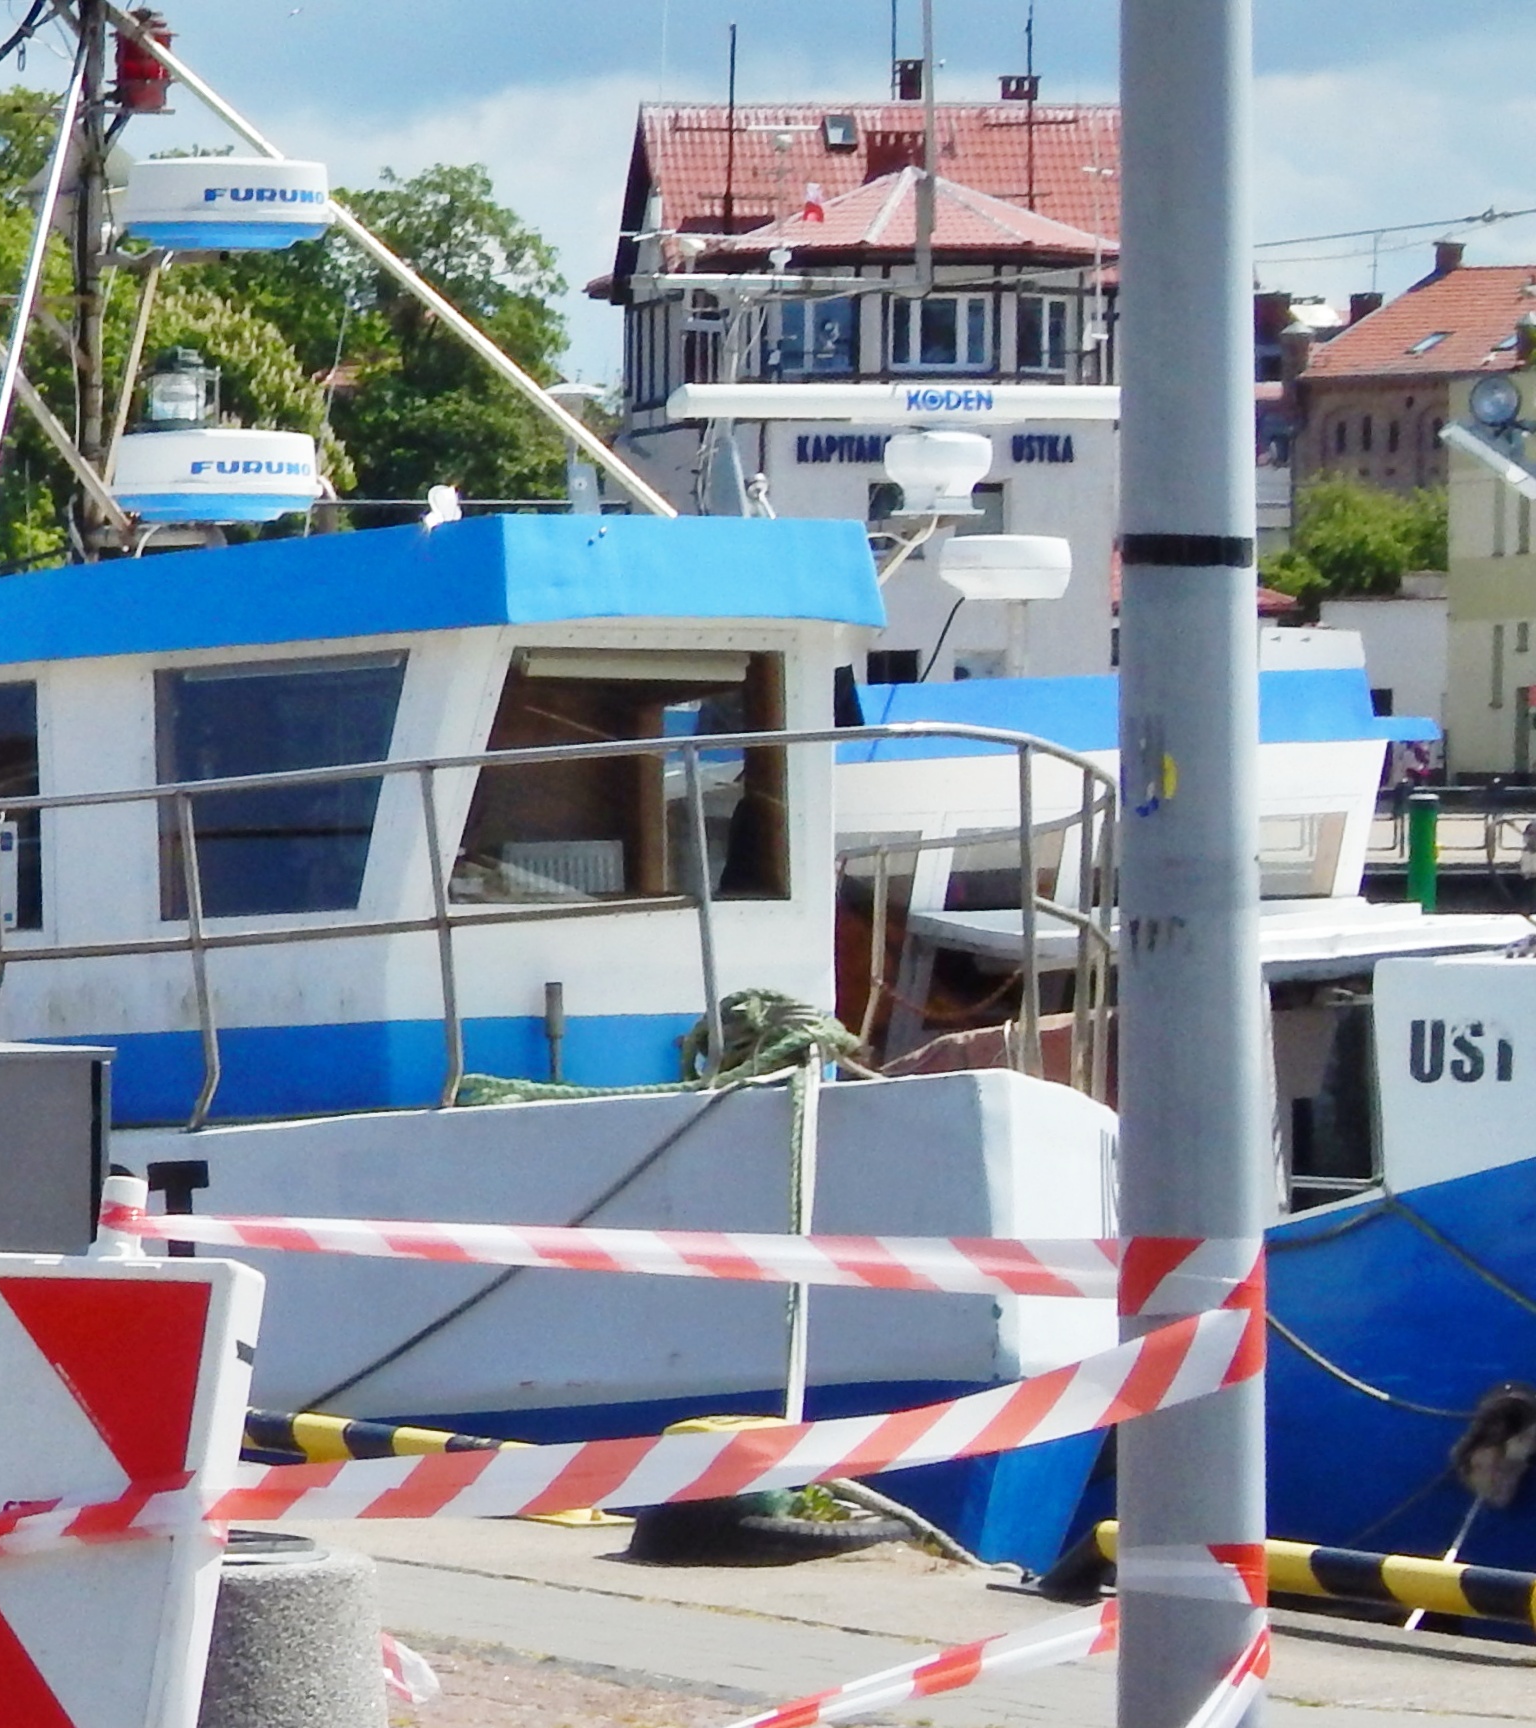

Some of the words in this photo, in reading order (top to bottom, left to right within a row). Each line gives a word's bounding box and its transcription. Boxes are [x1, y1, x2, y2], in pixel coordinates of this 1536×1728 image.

[203, 187, 325, 205] FURUNO
[905, 389, 994, 411] KODEN
[1011, 433, 1074, 464] USTKA
[190, 460, 311, 477] FURUNO
